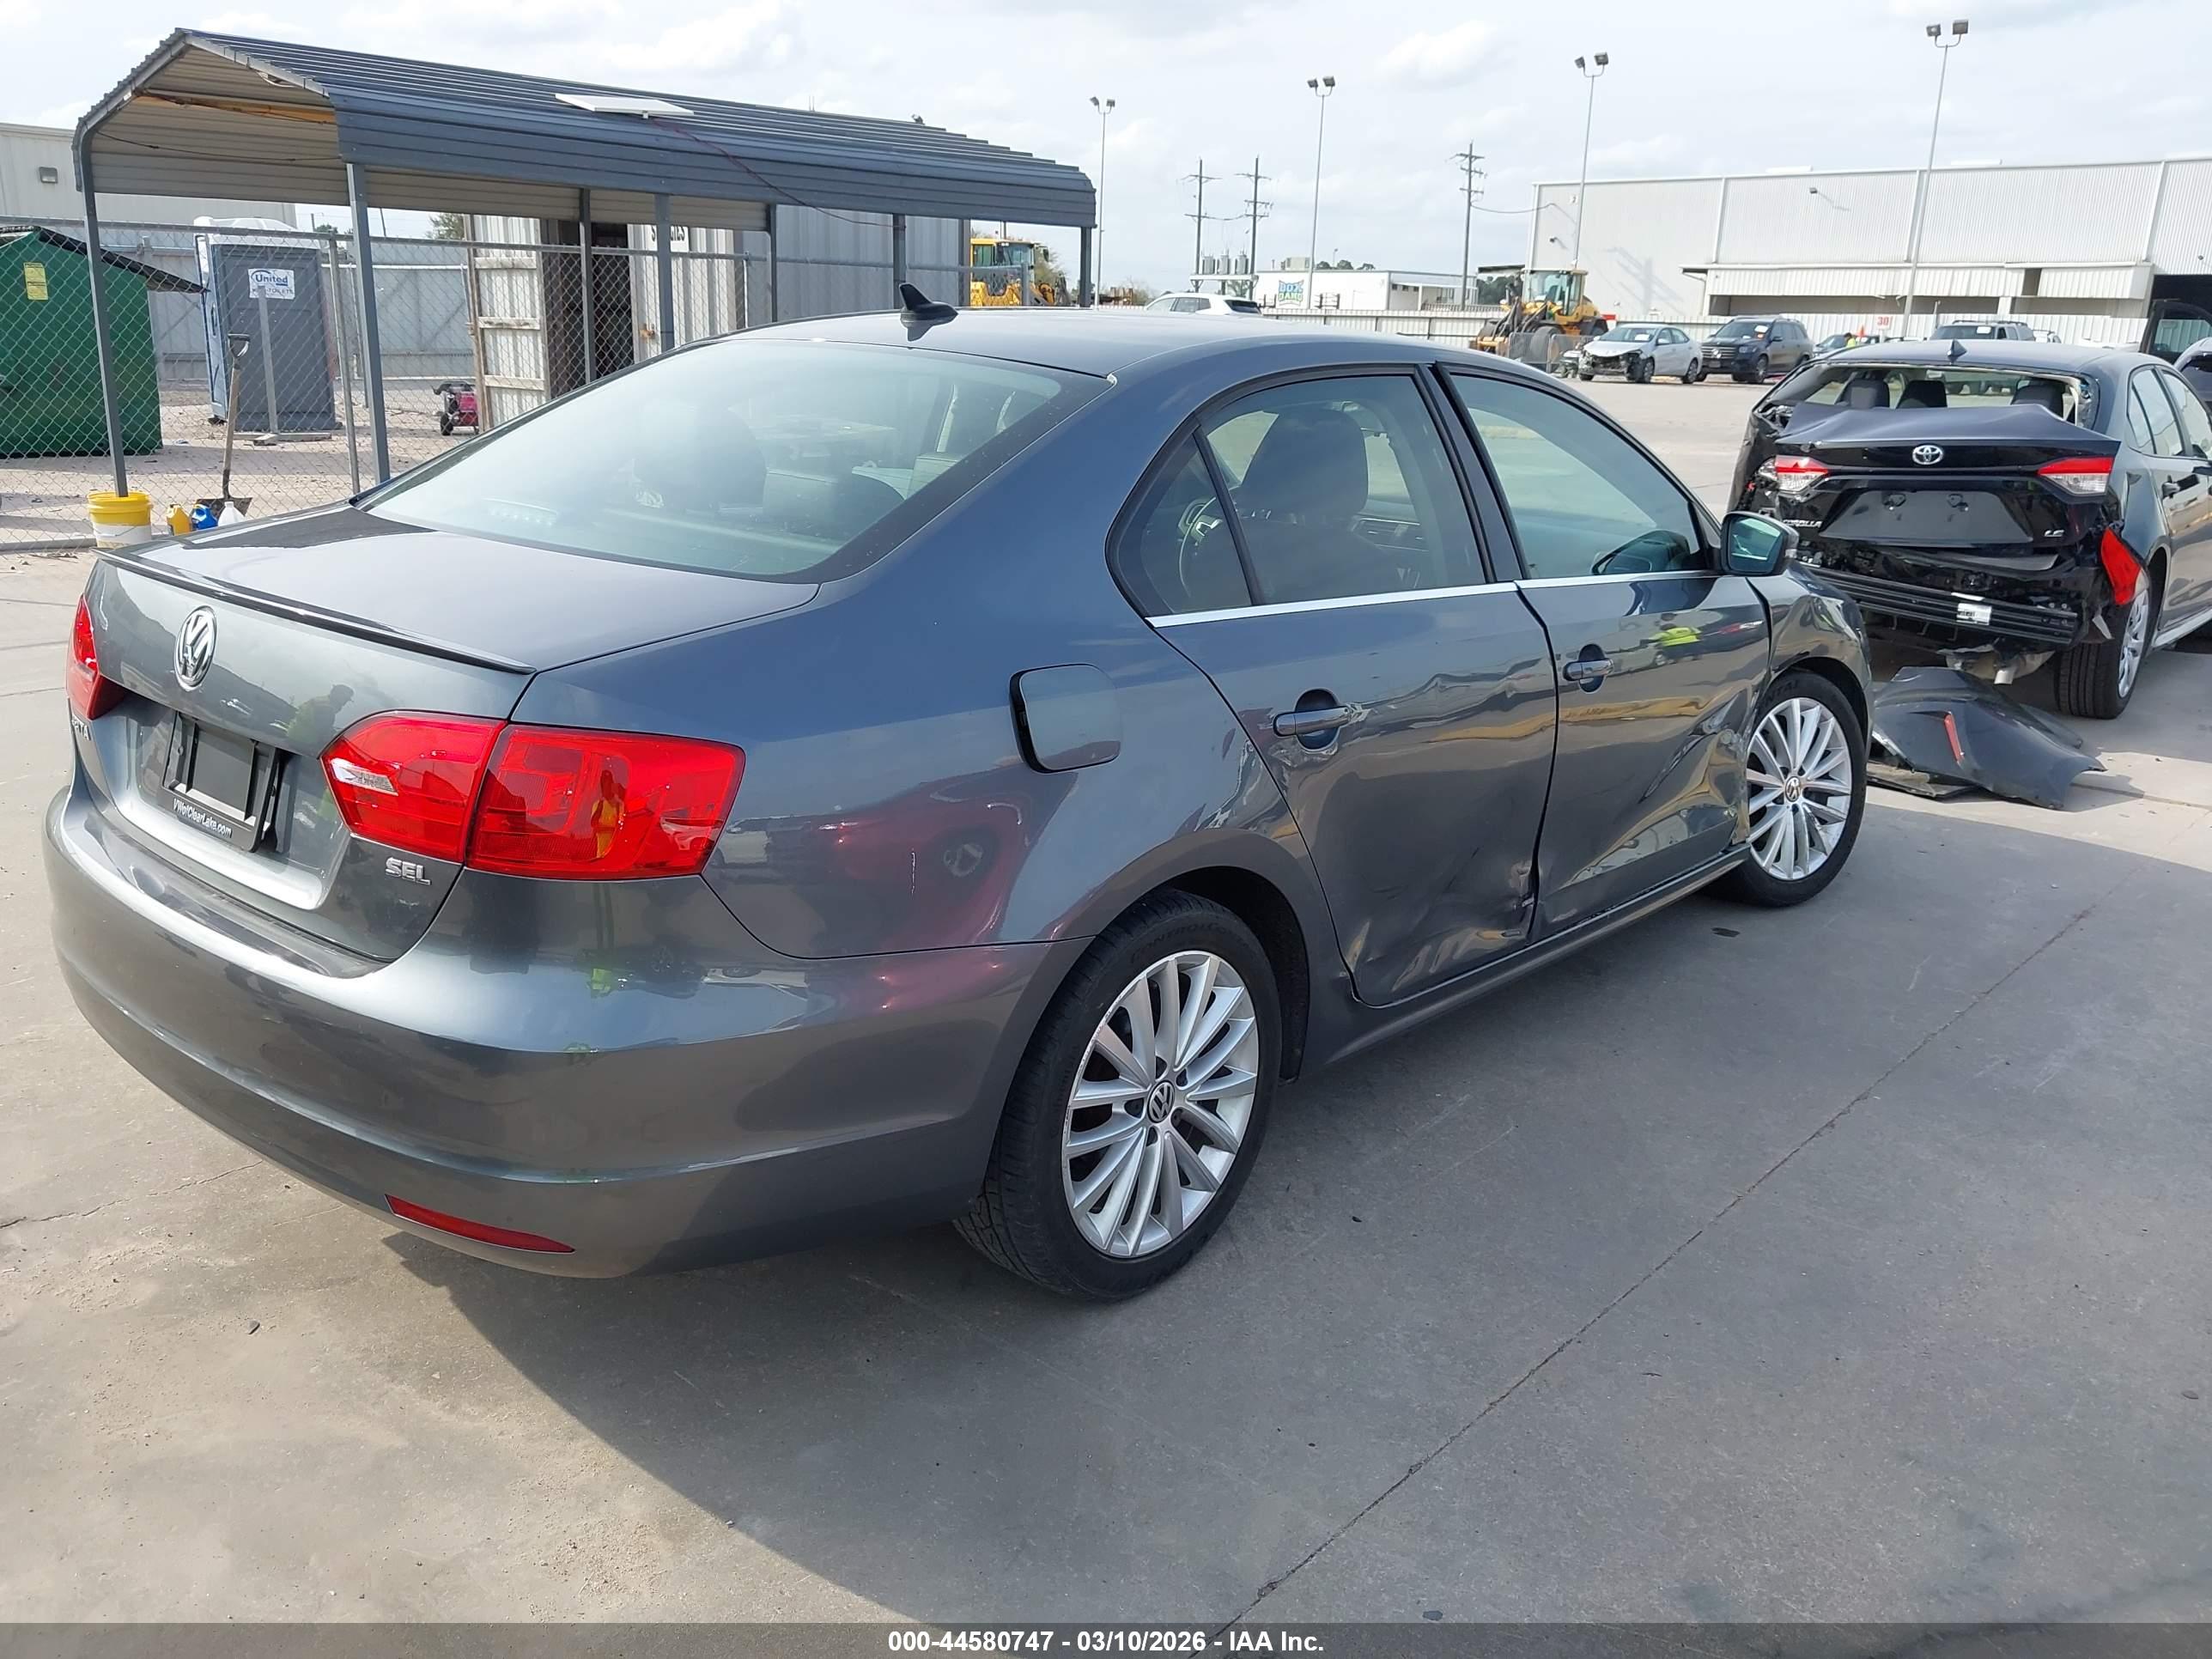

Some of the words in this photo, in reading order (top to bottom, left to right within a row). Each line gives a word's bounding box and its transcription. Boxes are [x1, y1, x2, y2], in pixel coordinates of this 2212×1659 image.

[255, 274, 289, 283] United
[1877, 316, 1889, 326] 30
[2045, 529, 2064, 538] LE
[173, 798, 233, 838] VWofClearLake.com
[385, 857, 431, 885] SEL
